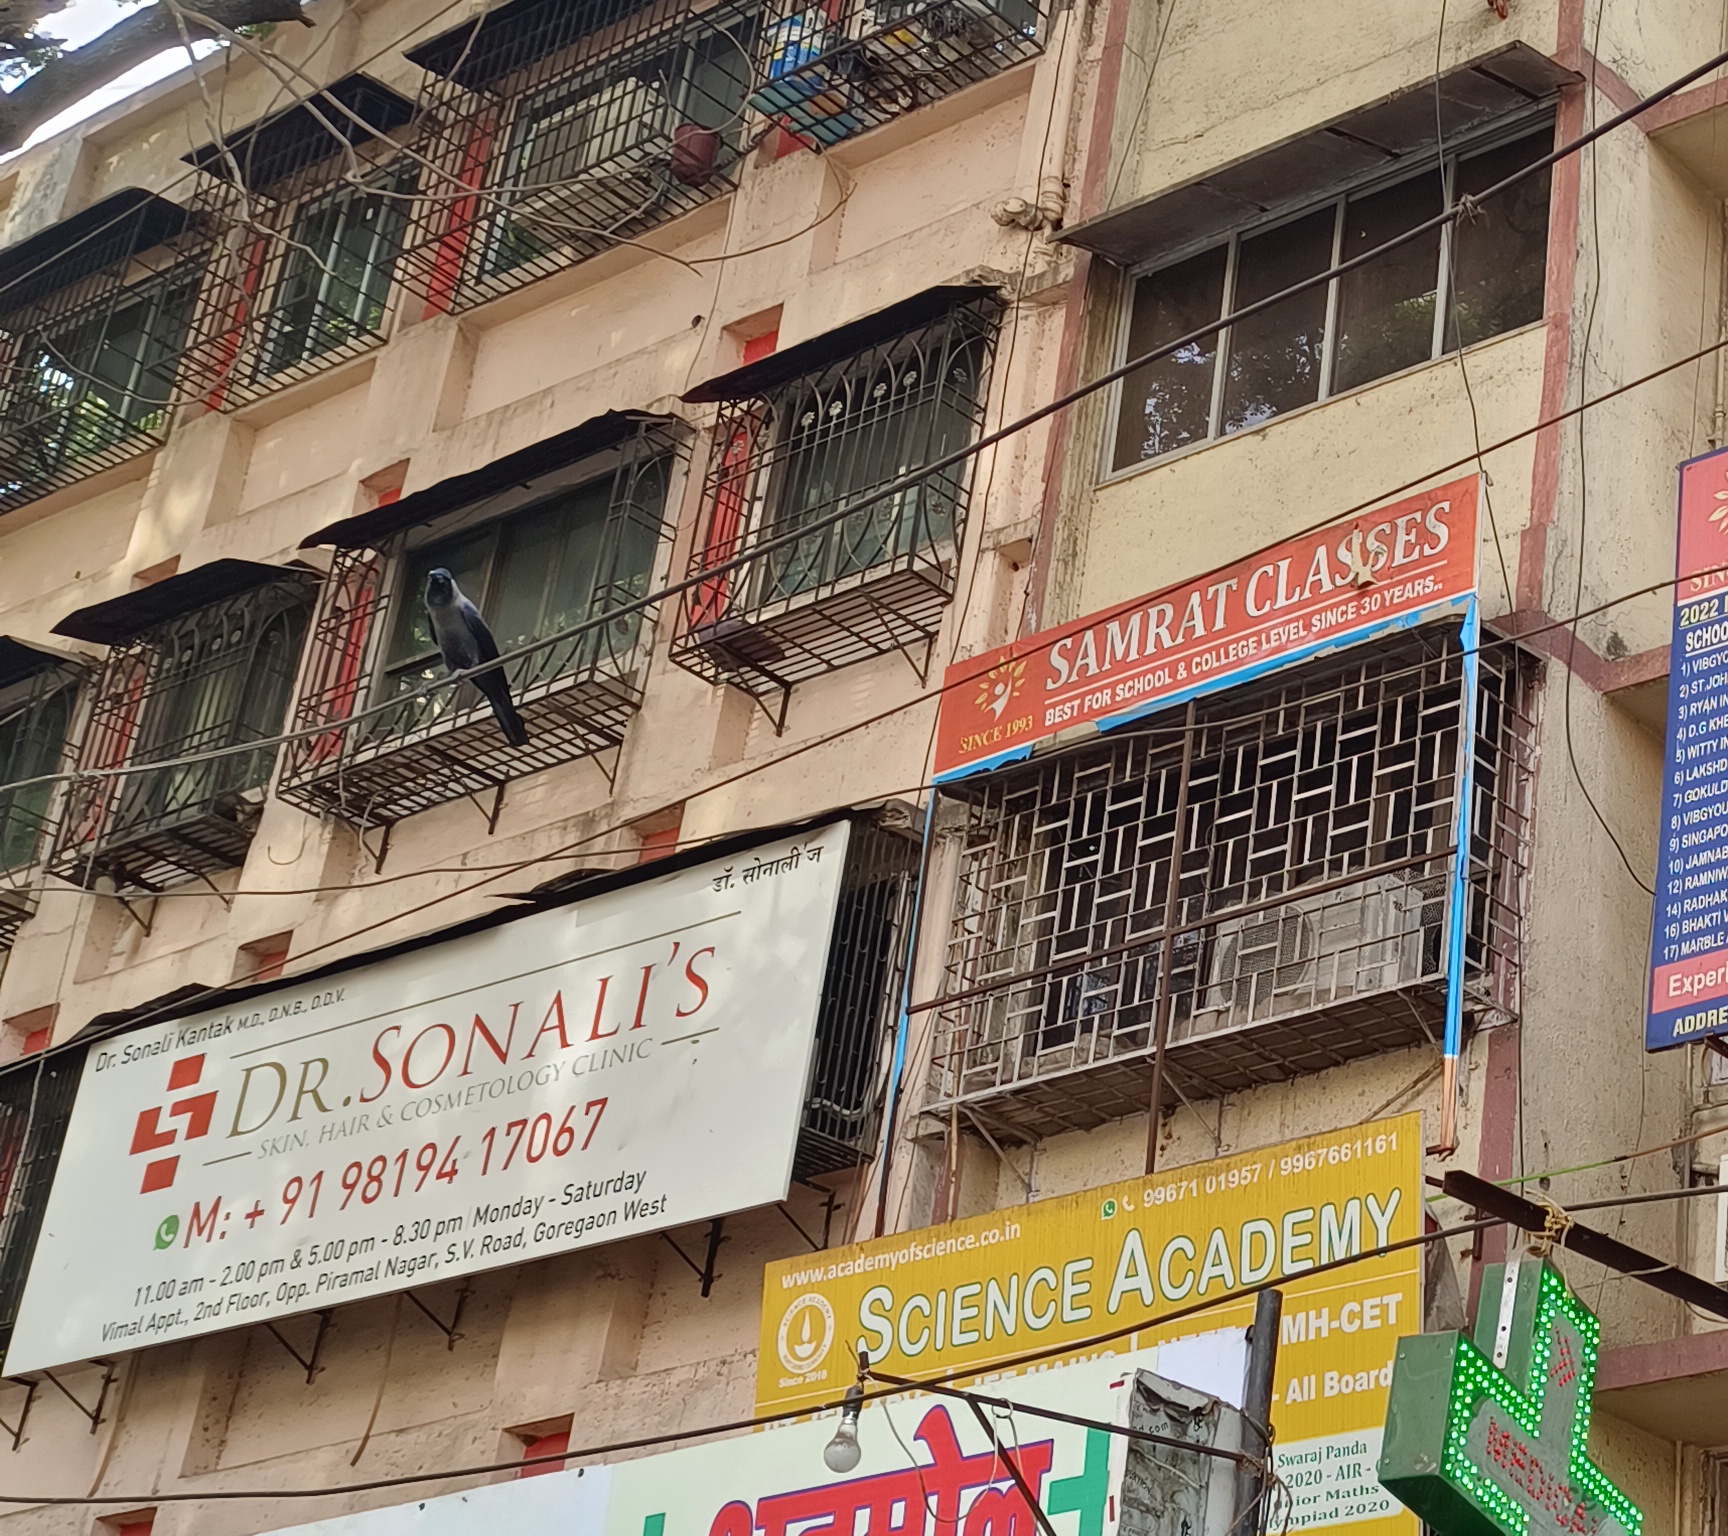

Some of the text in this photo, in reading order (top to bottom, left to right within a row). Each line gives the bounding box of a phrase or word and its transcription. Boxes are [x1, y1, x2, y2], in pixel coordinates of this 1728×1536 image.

[1045, 500, 1451, 692] SAMRAT CLASSES
[1680, 598, 1719, 627] 2022
[1044, 699, 1081, 728] BEST
[1083, 688, 1112, 714] FOR
[1115, 670, 1173, 702] SCHOOL
[1192, 636, 1258, 676] COLLEGE
[1261, 619, 1308, 651] LEVEL
[1311, 602, 1357, 633] SINCE
[1360, 592, 1381, 615] 30
[958, 715, 1034, 754] SINCE 1993
[120, 1015, 234, 1066] Sonali Kantak
[318, 1036, 654, 1144] HAIR COSMETOLOGY CLINIC
[280, 1096, 609, 1226] 91 98194 17067
[1143, 1131, 1399, 1209] 99671 01957 9967661161
[472, 1167, 648, 1228] Monday Saturday
[101, 1193, 668, 1343] Vimal Piramal Goregaon West
[781, 1220, 1022, 1290] www.academyofscience.co.in
[856, 1186, 1402, 1366] SCIENCE ACADEMY
[1281, 1292, 1404, 1346] MH-CET
[1285, 1376, 1316, 1406] All
[1277, 1440, 1368, 1469] Swaraj Panda
[1325, 1482, 1380, 1502] Maths
[1344, 1498, 1391, 1518] 2020
